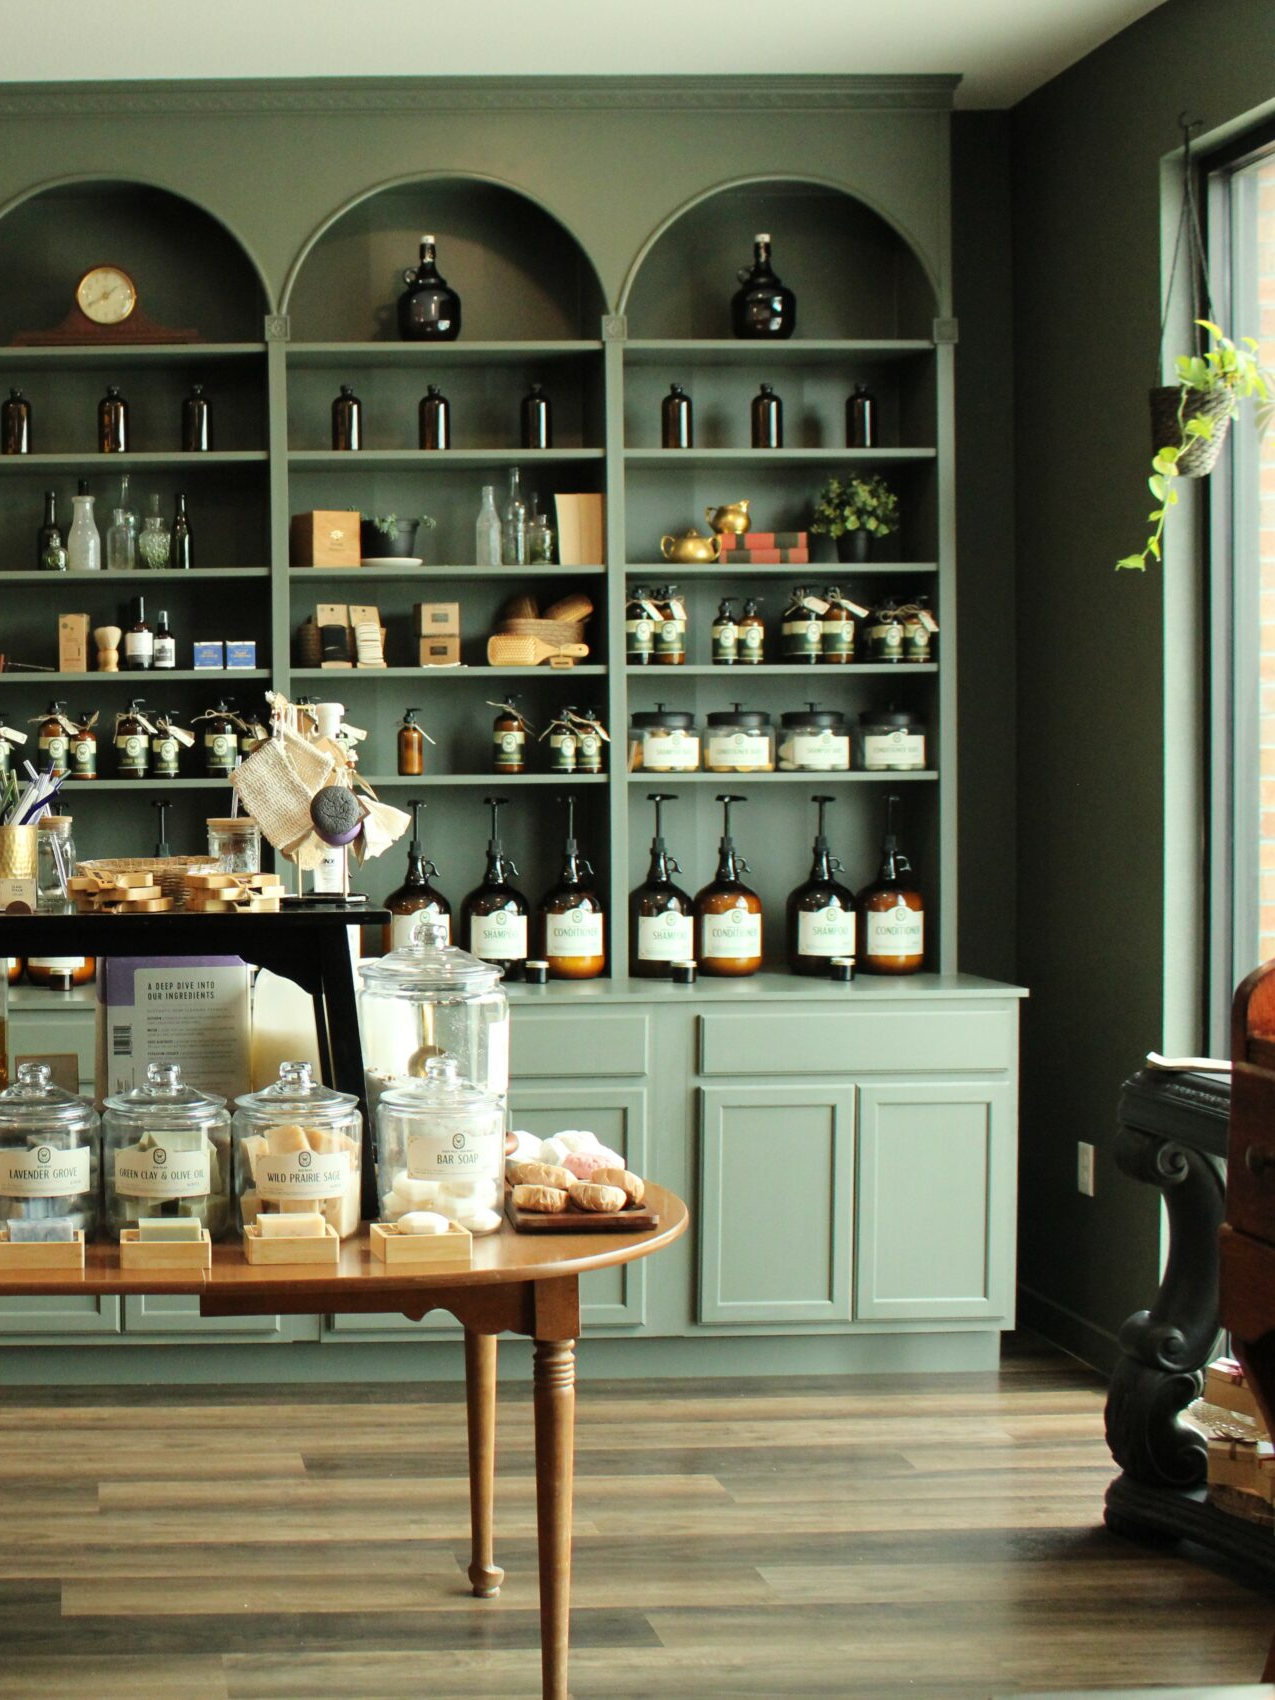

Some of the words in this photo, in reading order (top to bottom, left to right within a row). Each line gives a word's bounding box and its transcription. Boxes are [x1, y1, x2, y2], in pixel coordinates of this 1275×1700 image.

[155, 982, 174, 990] DEEP
[177, 981, 194, 990] DIVE
[197, 981, 215, 989] INTO
[147, 992, 162, 1000] OUR
[165, 991, 215, 1000] INGREDIENTS
[436, 1154, 454, 1165] BAR
[457, 1153, 479, 1165] SOAP
[9, 1169, 50, 1180] LAVENDER
[52, 1167, 78, 1179] GROVE
[119, 1167, 139, 1179] GREEN
[140, 1171, 158, 1180] CLAY
[160, 1171, 168, 1180] &
[170, 1170, 191, 1180] OLIVE
[193, 1169, 205, 1178] OIL
[267, 1172, 287, 1183] WILD
[289, 1172, 321, 1183] PRAIRIE
[323, 1170, 341, 1181] SAGE
